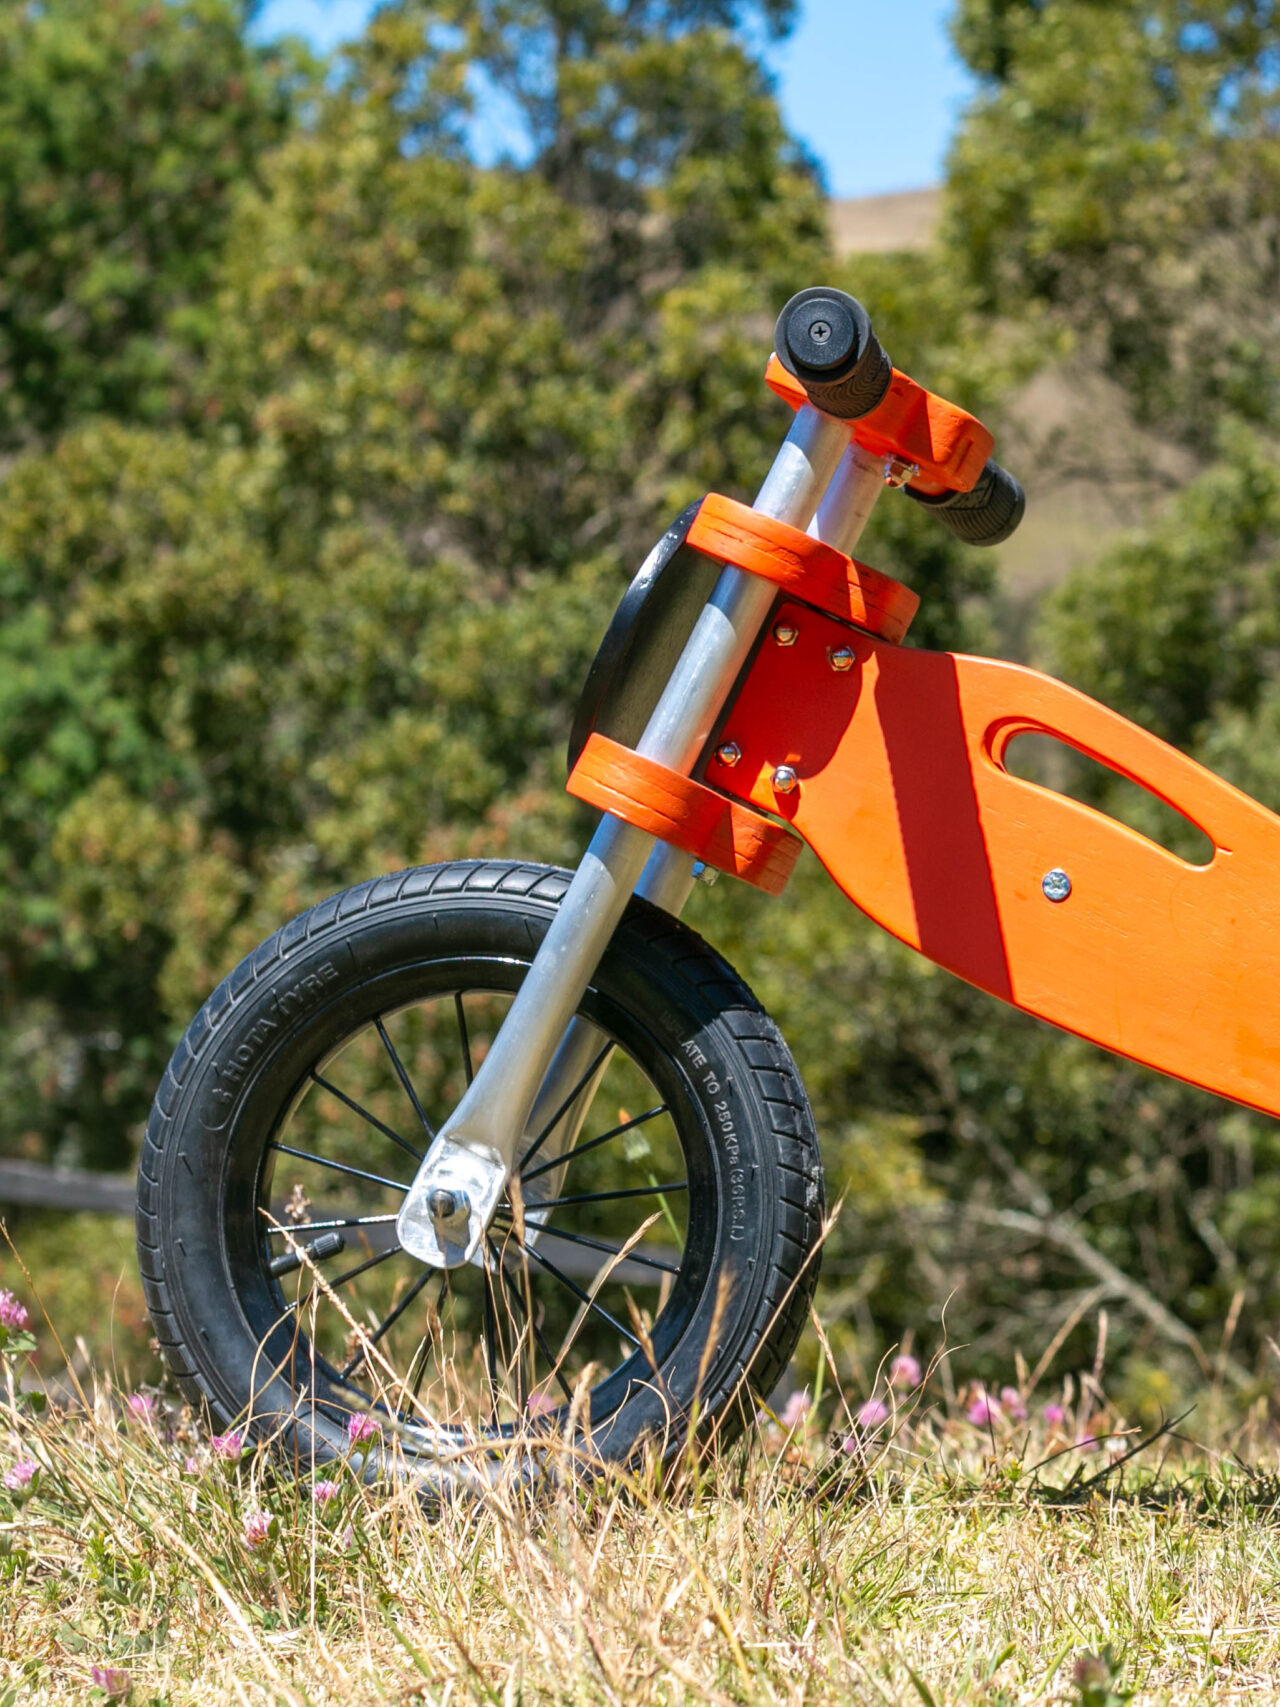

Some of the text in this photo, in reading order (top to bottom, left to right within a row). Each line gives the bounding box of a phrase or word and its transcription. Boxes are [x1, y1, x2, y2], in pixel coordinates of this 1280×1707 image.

[222, 961, 339, 1081] HOTA TYRE
[702, 1070, 721, 1095] TO
